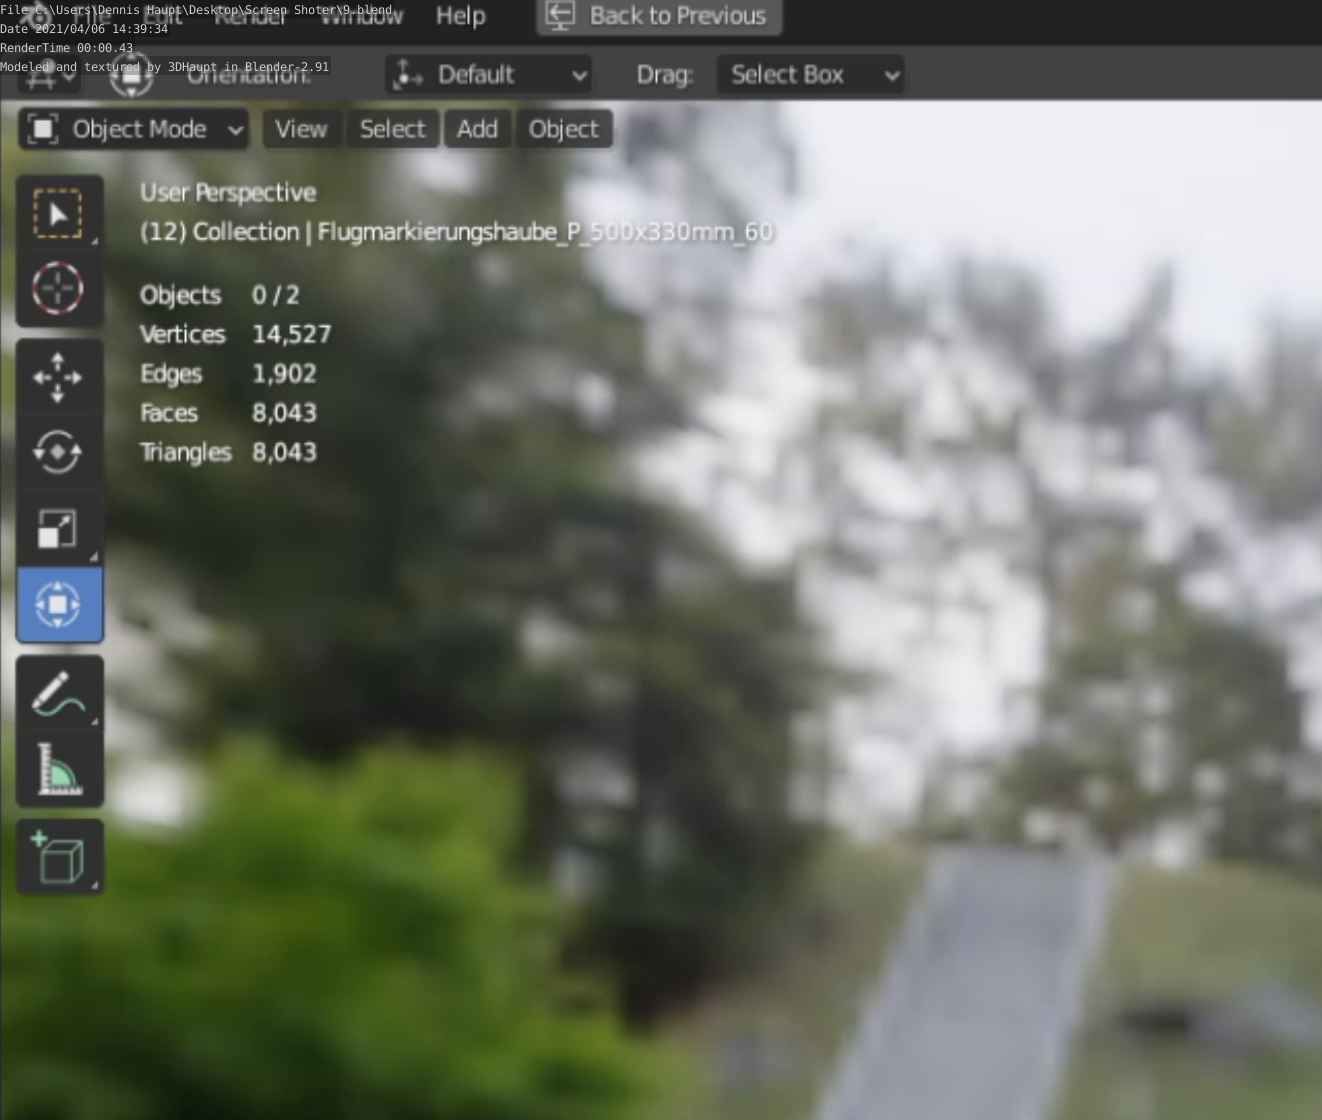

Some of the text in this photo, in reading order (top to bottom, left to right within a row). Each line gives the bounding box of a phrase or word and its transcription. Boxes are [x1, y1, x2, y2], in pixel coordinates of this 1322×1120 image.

[437, 6, 487, 27] Help
[590, 5, 767, 26] Back to Previous
[439, 65, 515, 85] Default
[637, 65, 694, 89] Drag:
[731, 64, 844, 85] Select Box
[73, 118, 207, 142] Object Mode
[275, 119, 327, 139] View
[360, 118, 427, 139] Select
[457, 118, 498, 139] Add
[529, 118, 600, 143] Object
[140, 181, 317, 207] User Perspective
[140, 221, 186, 245] (12)
[193, 221, 300, 241] Collection
[139, 284, 222, 309] Objects
[252, 285, 266, 305] 0
[287, 285, 300, 305] 2
[139, 324, 332, 347] Vertices 14,527
[140, 362, 317, 389] Edges 1,902
[140, 402, 317, 427] Faces 8,043
[139, 442, 317, 467] Triangles 8,043
